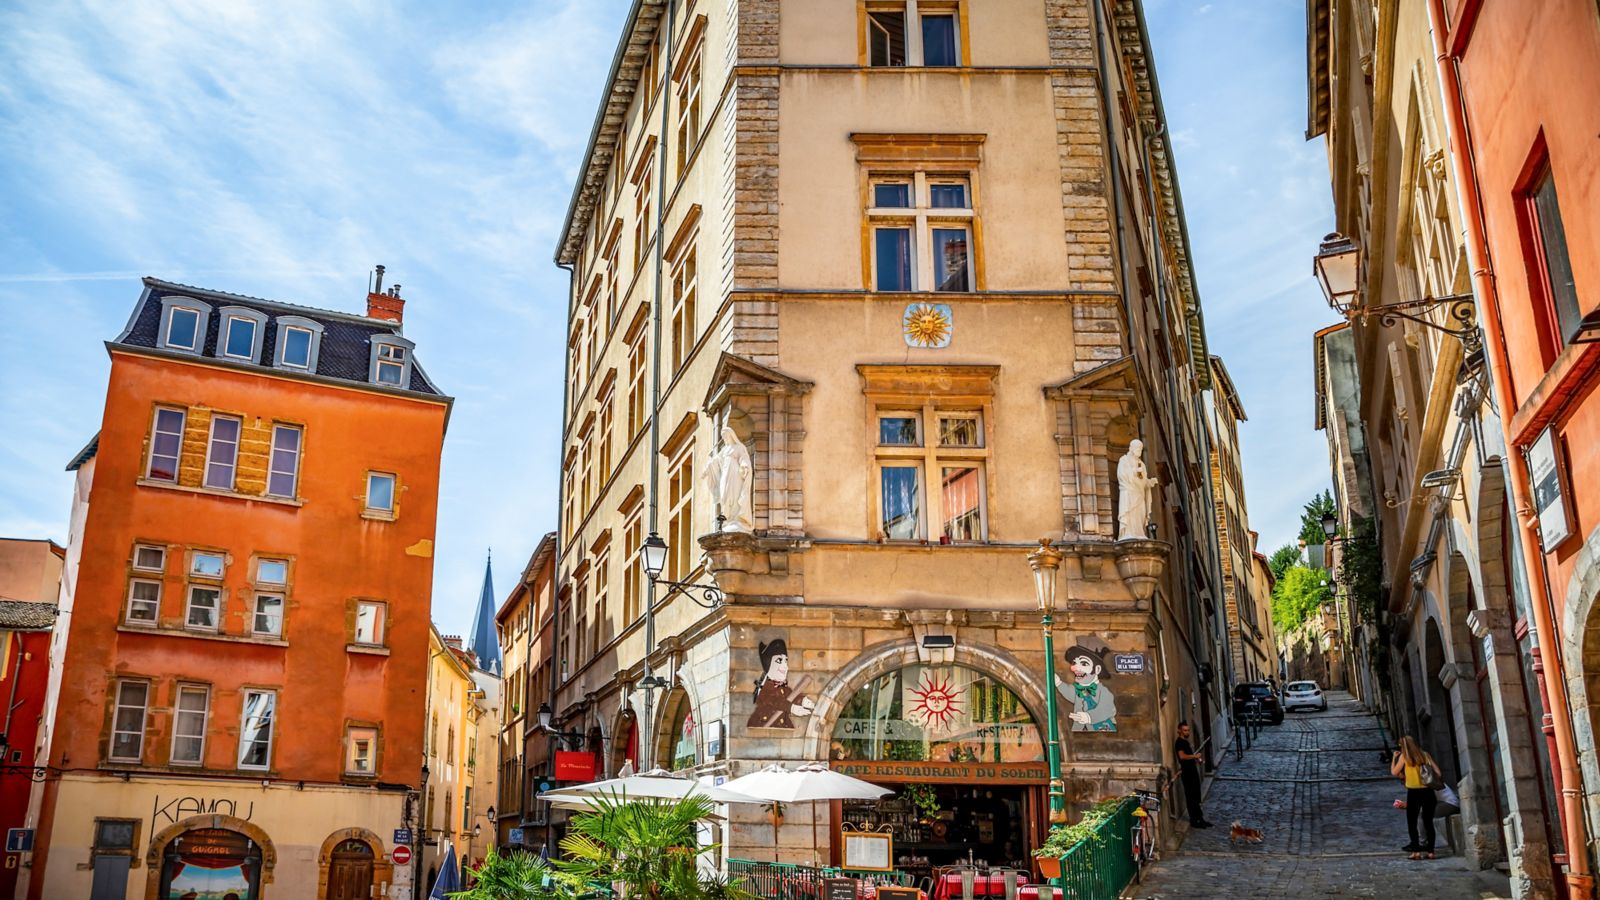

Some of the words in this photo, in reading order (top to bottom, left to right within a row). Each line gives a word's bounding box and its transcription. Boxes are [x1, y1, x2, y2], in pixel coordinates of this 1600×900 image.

[876, 765, 969, 778] RESTAURANT
[975, 767, 996, 778] DU
[1000, 768, 1046, 779] SOLEIL
